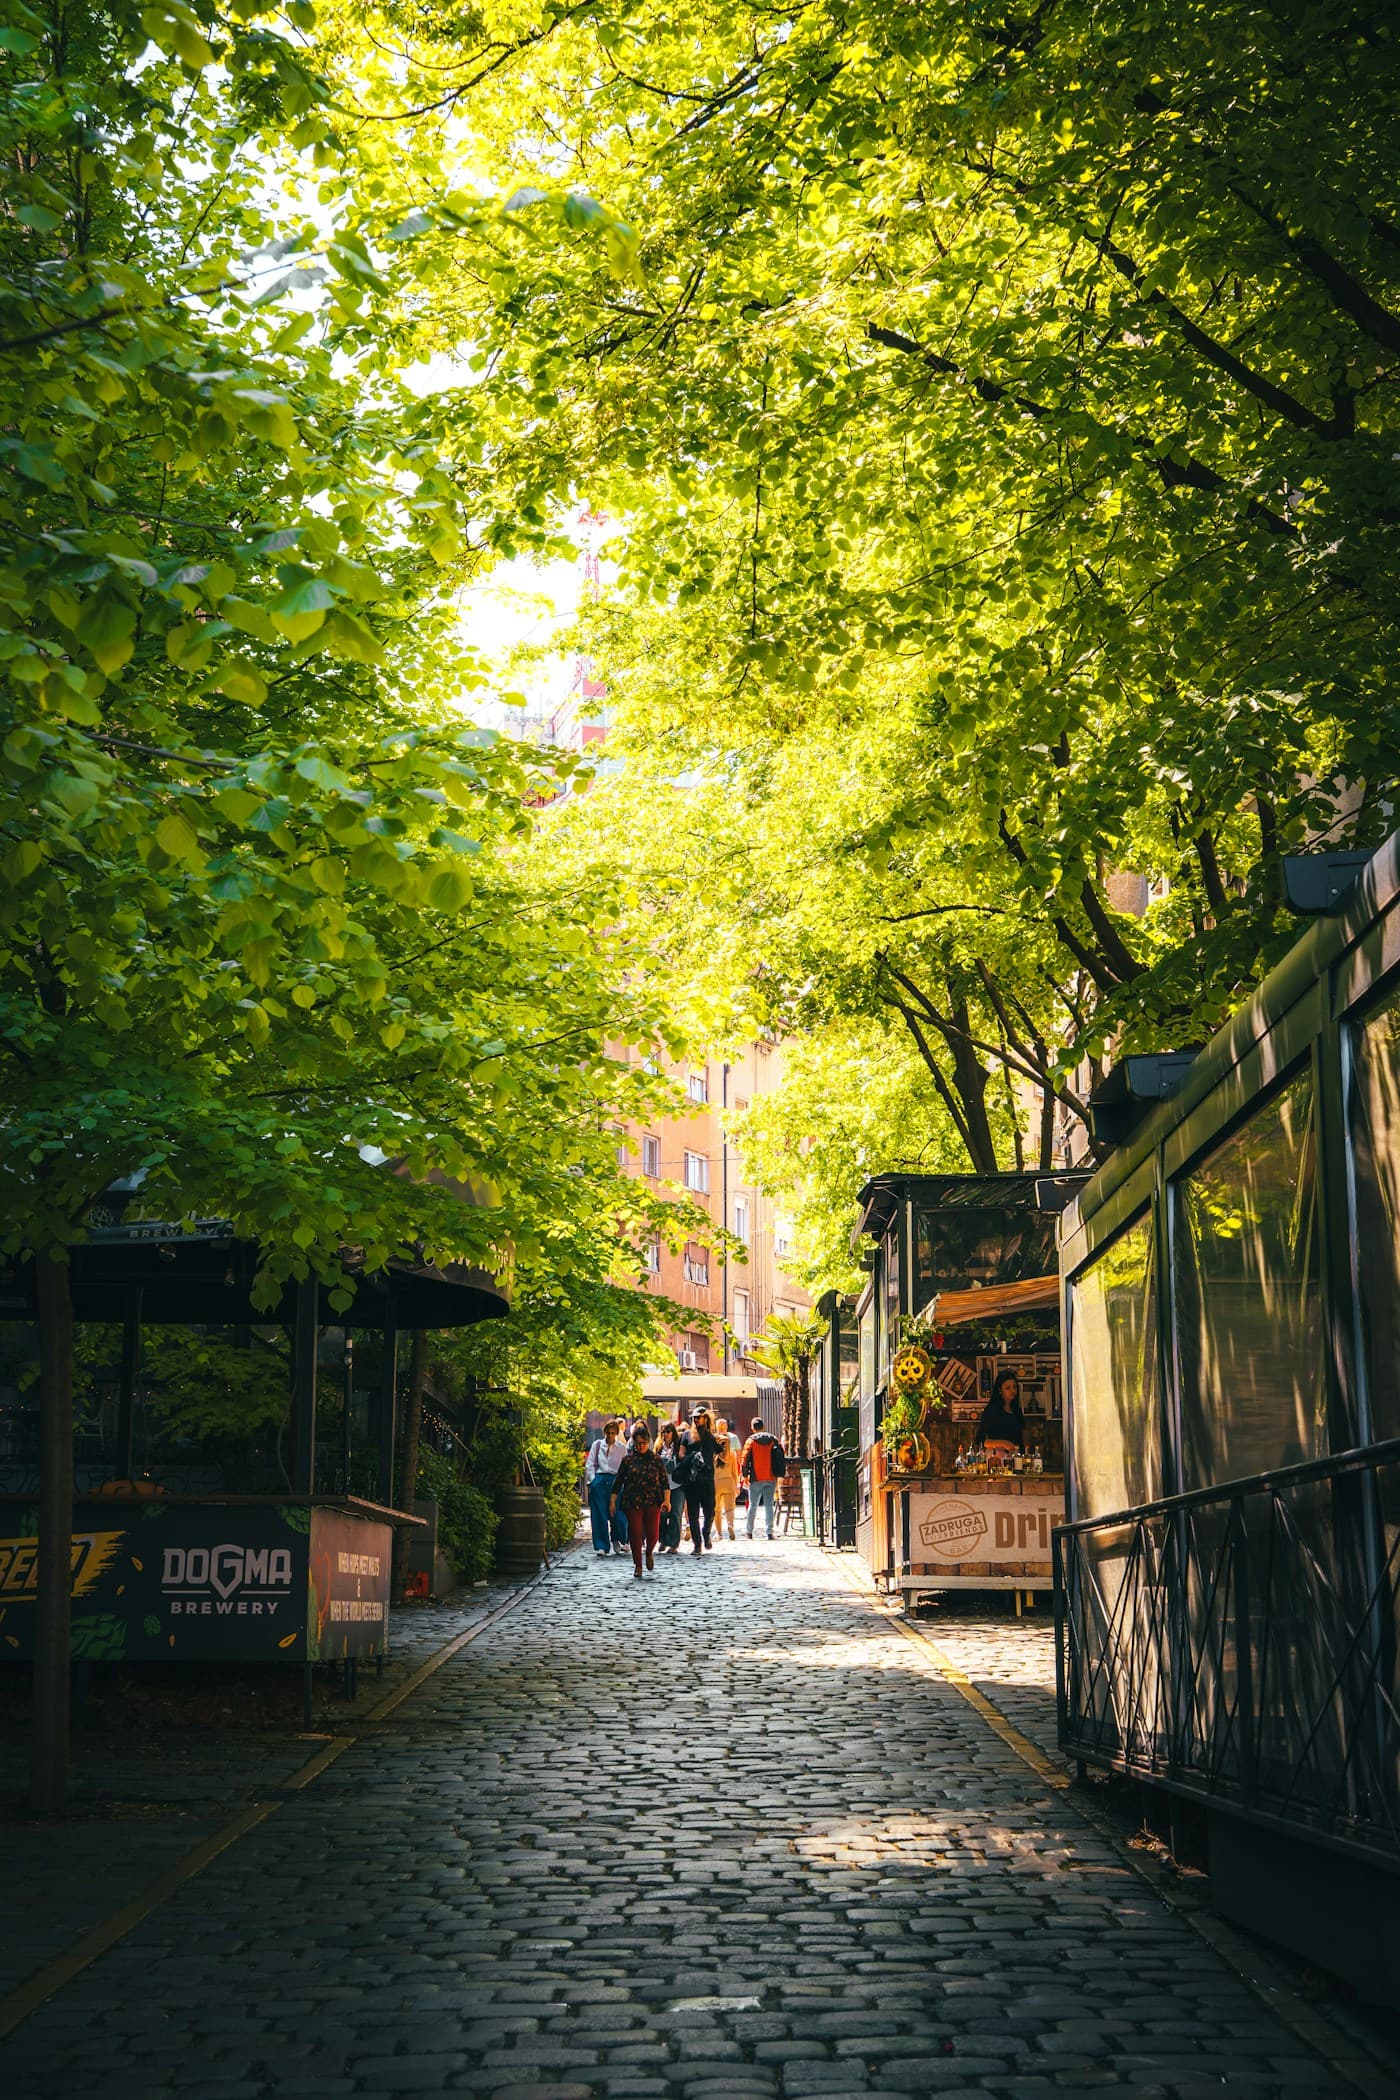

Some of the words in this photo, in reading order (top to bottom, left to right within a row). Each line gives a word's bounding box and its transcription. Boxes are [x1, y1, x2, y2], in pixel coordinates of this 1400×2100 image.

[923, 1515, 982, 1536] ZADRUGA
[943, 1524, 984, 1539] FRIENDS
[161, 1543, 292, 1600] DOGMA
[170, 1601, 279, 1615] BREWERY
